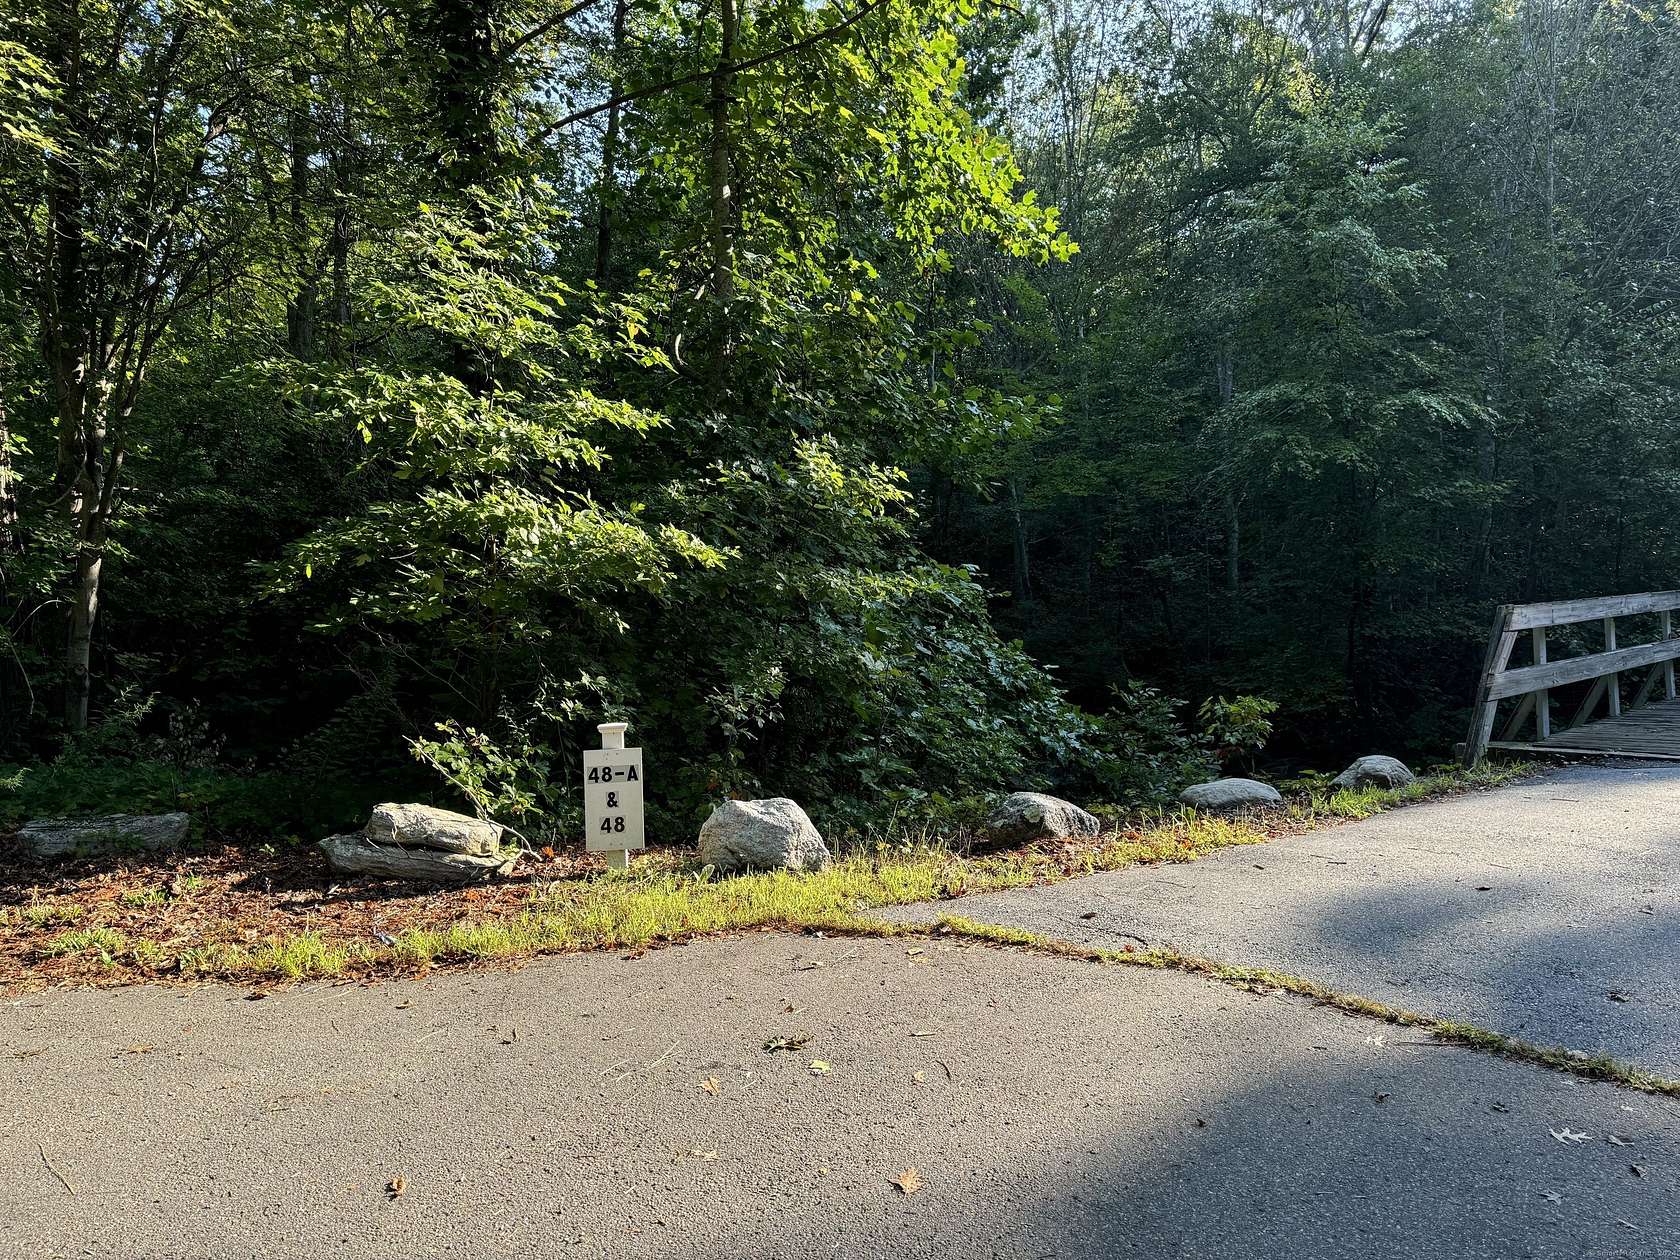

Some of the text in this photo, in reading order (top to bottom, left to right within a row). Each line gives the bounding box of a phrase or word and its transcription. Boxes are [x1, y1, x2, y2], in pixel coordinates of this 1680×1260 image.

[588, 765, 639, 783] 48-A
[606, 791, 618, 808] &
[600, 816, 625, 833] 48
